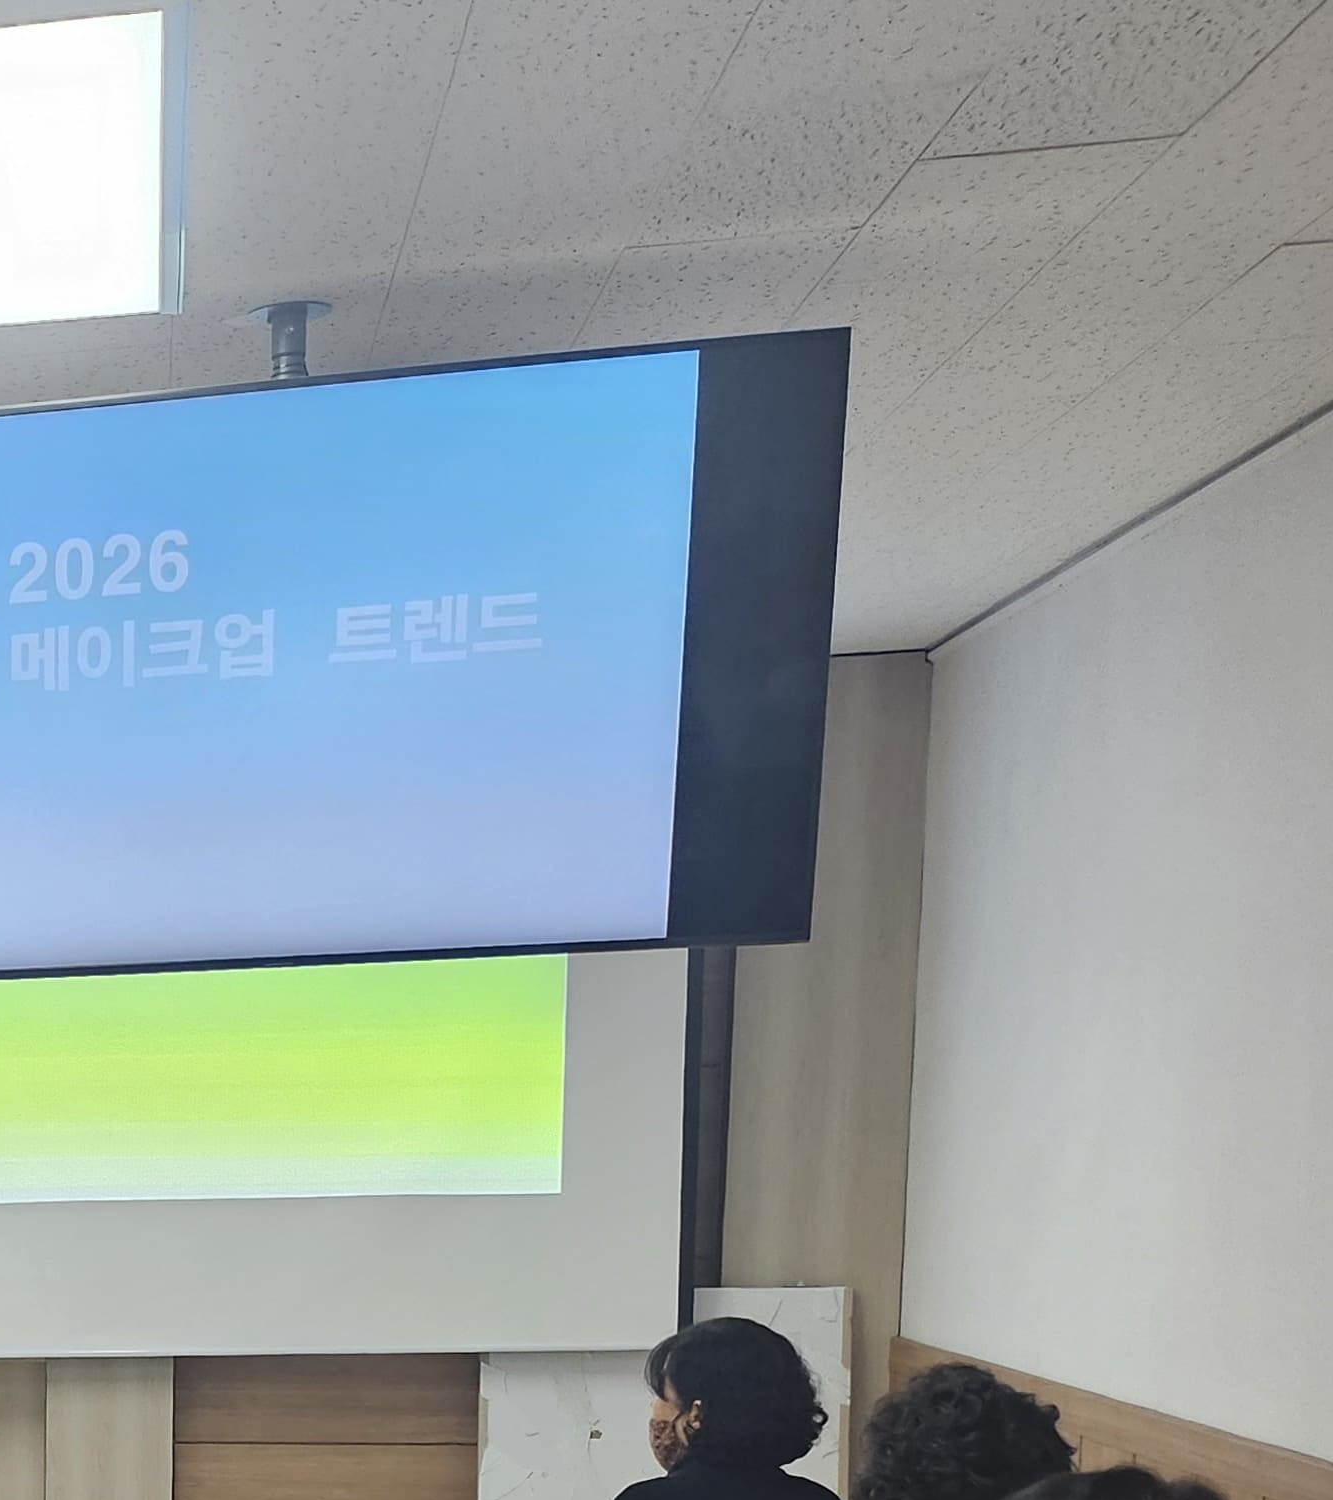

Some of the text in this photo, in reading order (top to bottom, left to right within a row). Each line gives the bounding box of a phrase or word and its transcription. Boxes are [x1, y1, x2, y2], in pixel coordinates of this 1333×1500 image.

[9, 529, 189, 604] 2026
[9, 592, 542, 691] 메이크업 트렌드
